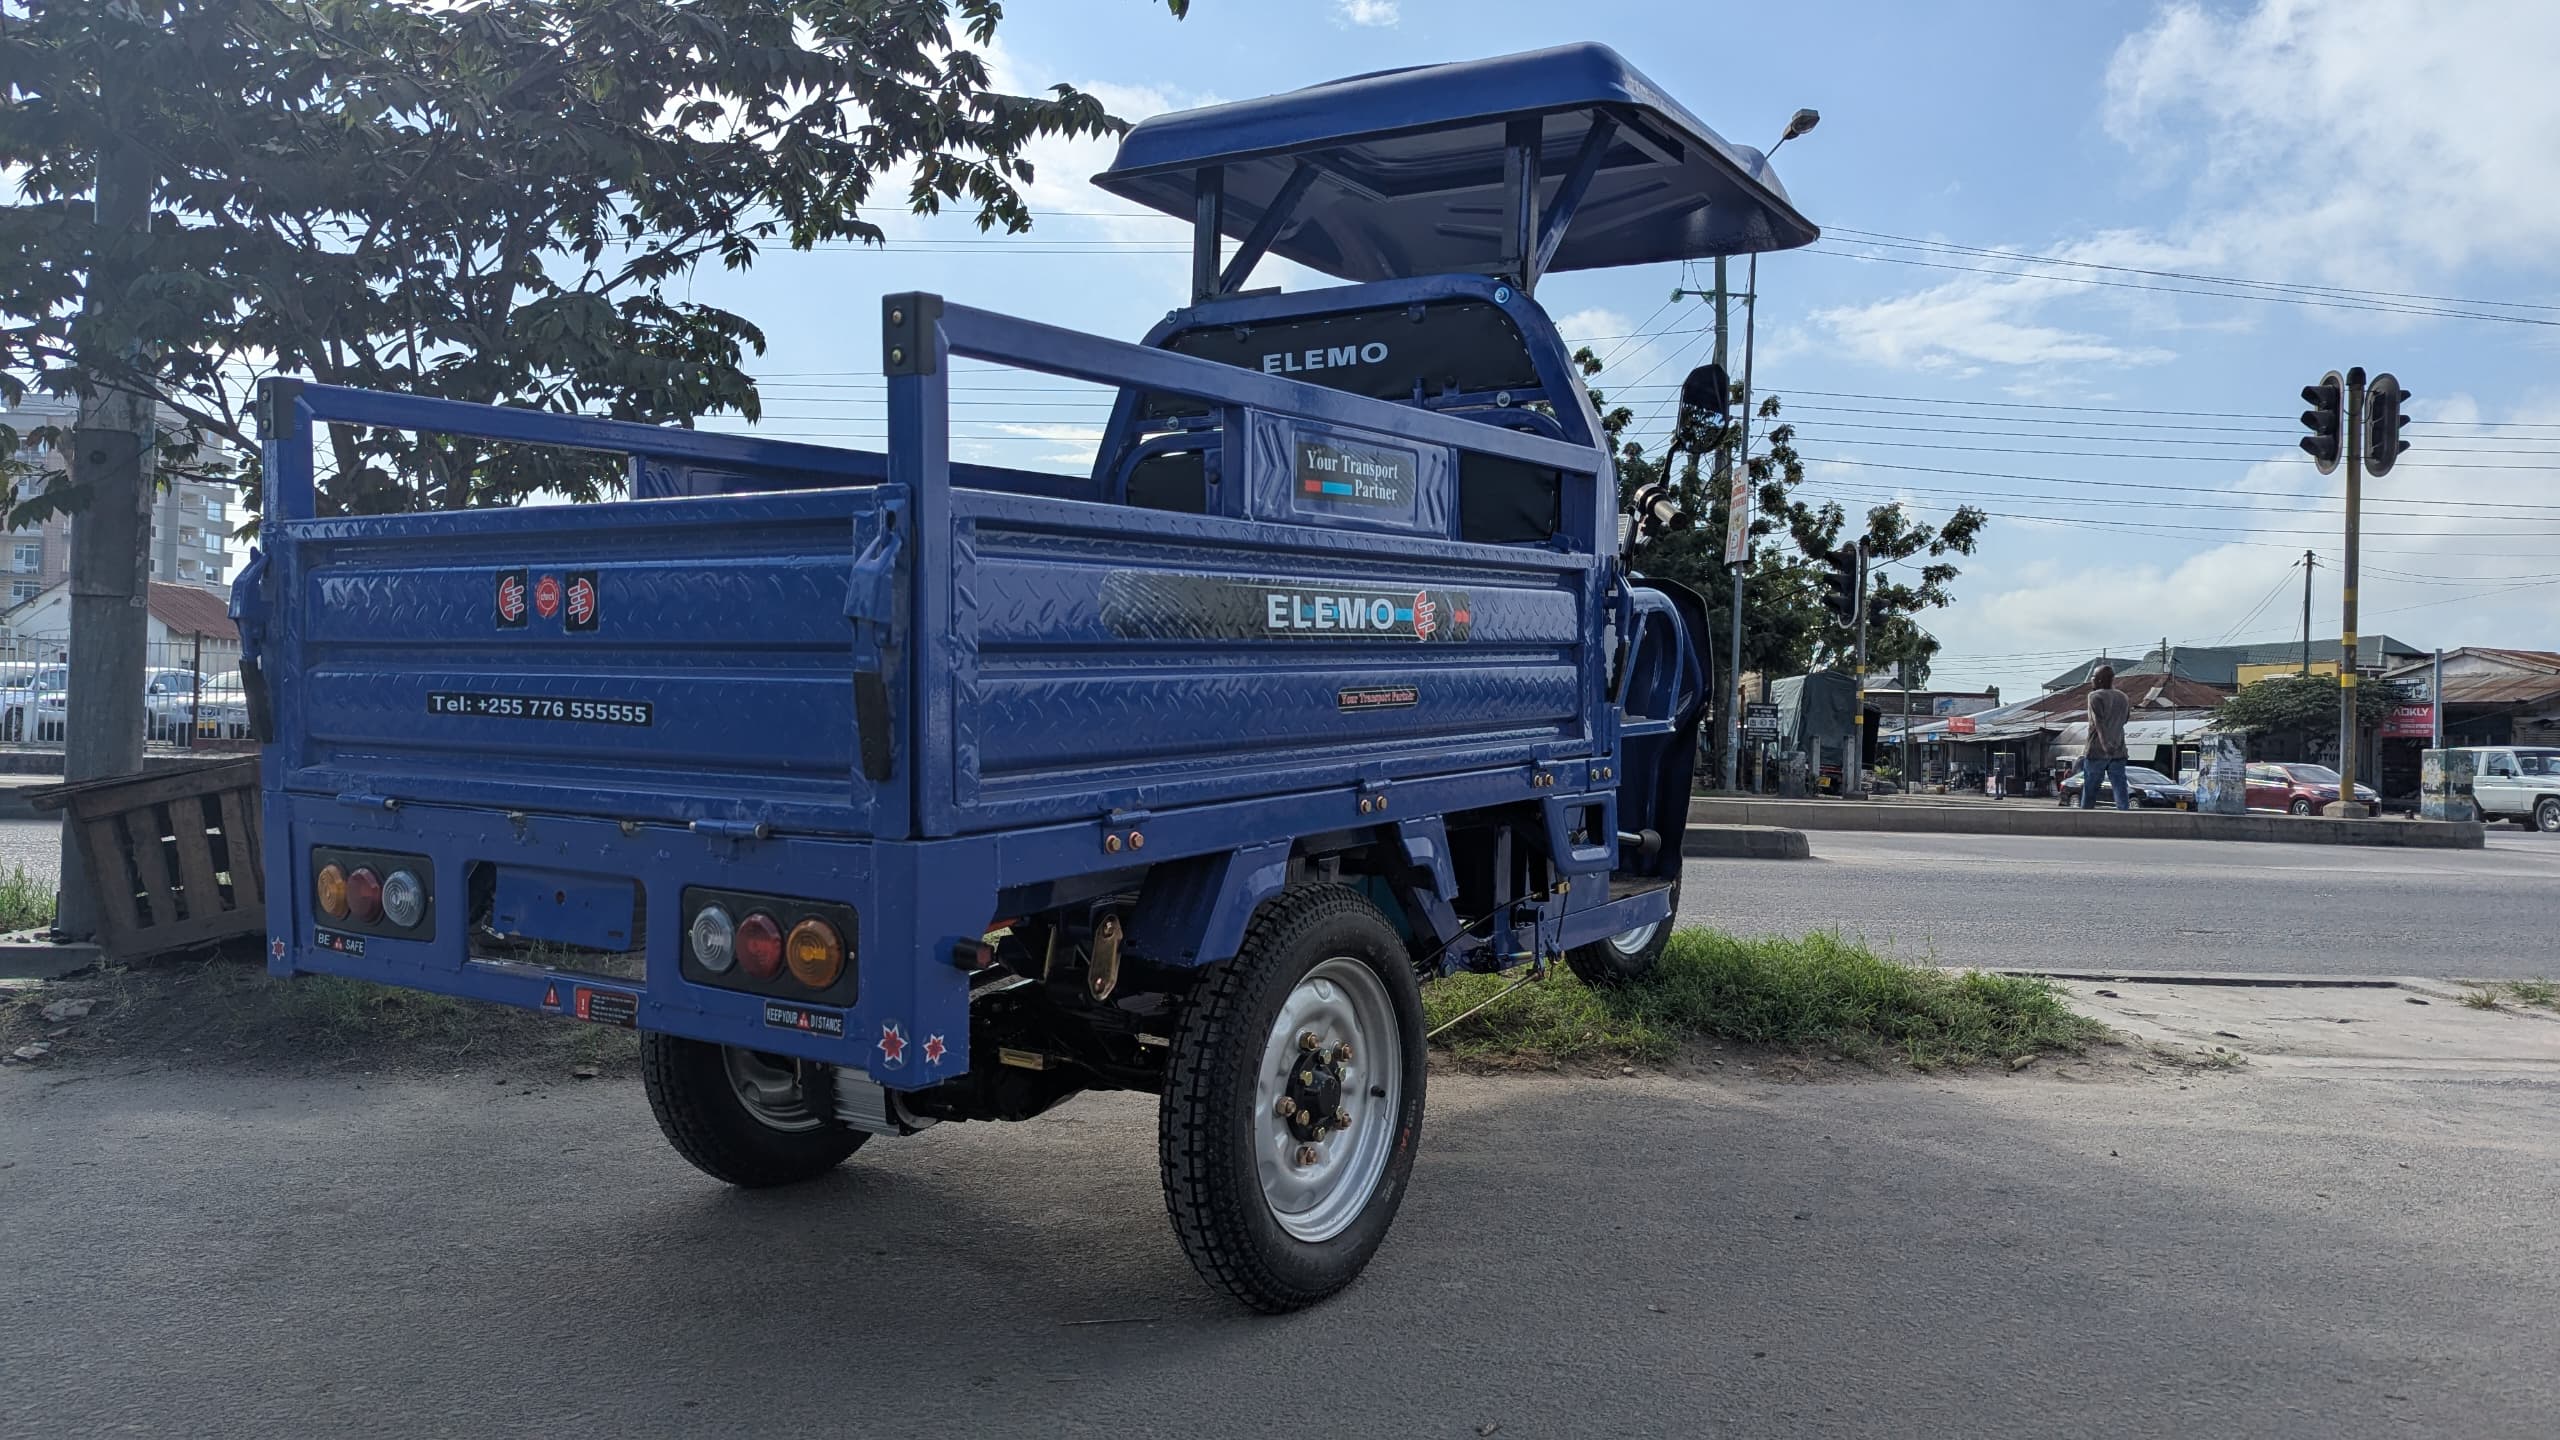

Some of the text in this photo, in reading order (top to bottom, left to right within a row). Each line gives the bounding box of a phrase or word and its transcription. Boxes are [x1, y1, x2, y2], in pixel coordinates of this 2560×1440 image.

[1263, 342, 1388, 374] ELEMO
[1306, 449, 1398, 481] Your Transport
[1354, 479, 1398, 501] Partner
[1267, 594, 1395, 630] ELEMO
[432, 696, 648, 723] Tel: +255 776 555555
[1341, 694, 1359, 705] Your
[1359, 691, 1391, 705] Transport
[318, 932, 365, 953] BE SAFE
[810, 1014, 842, 1033] DISTANCE
